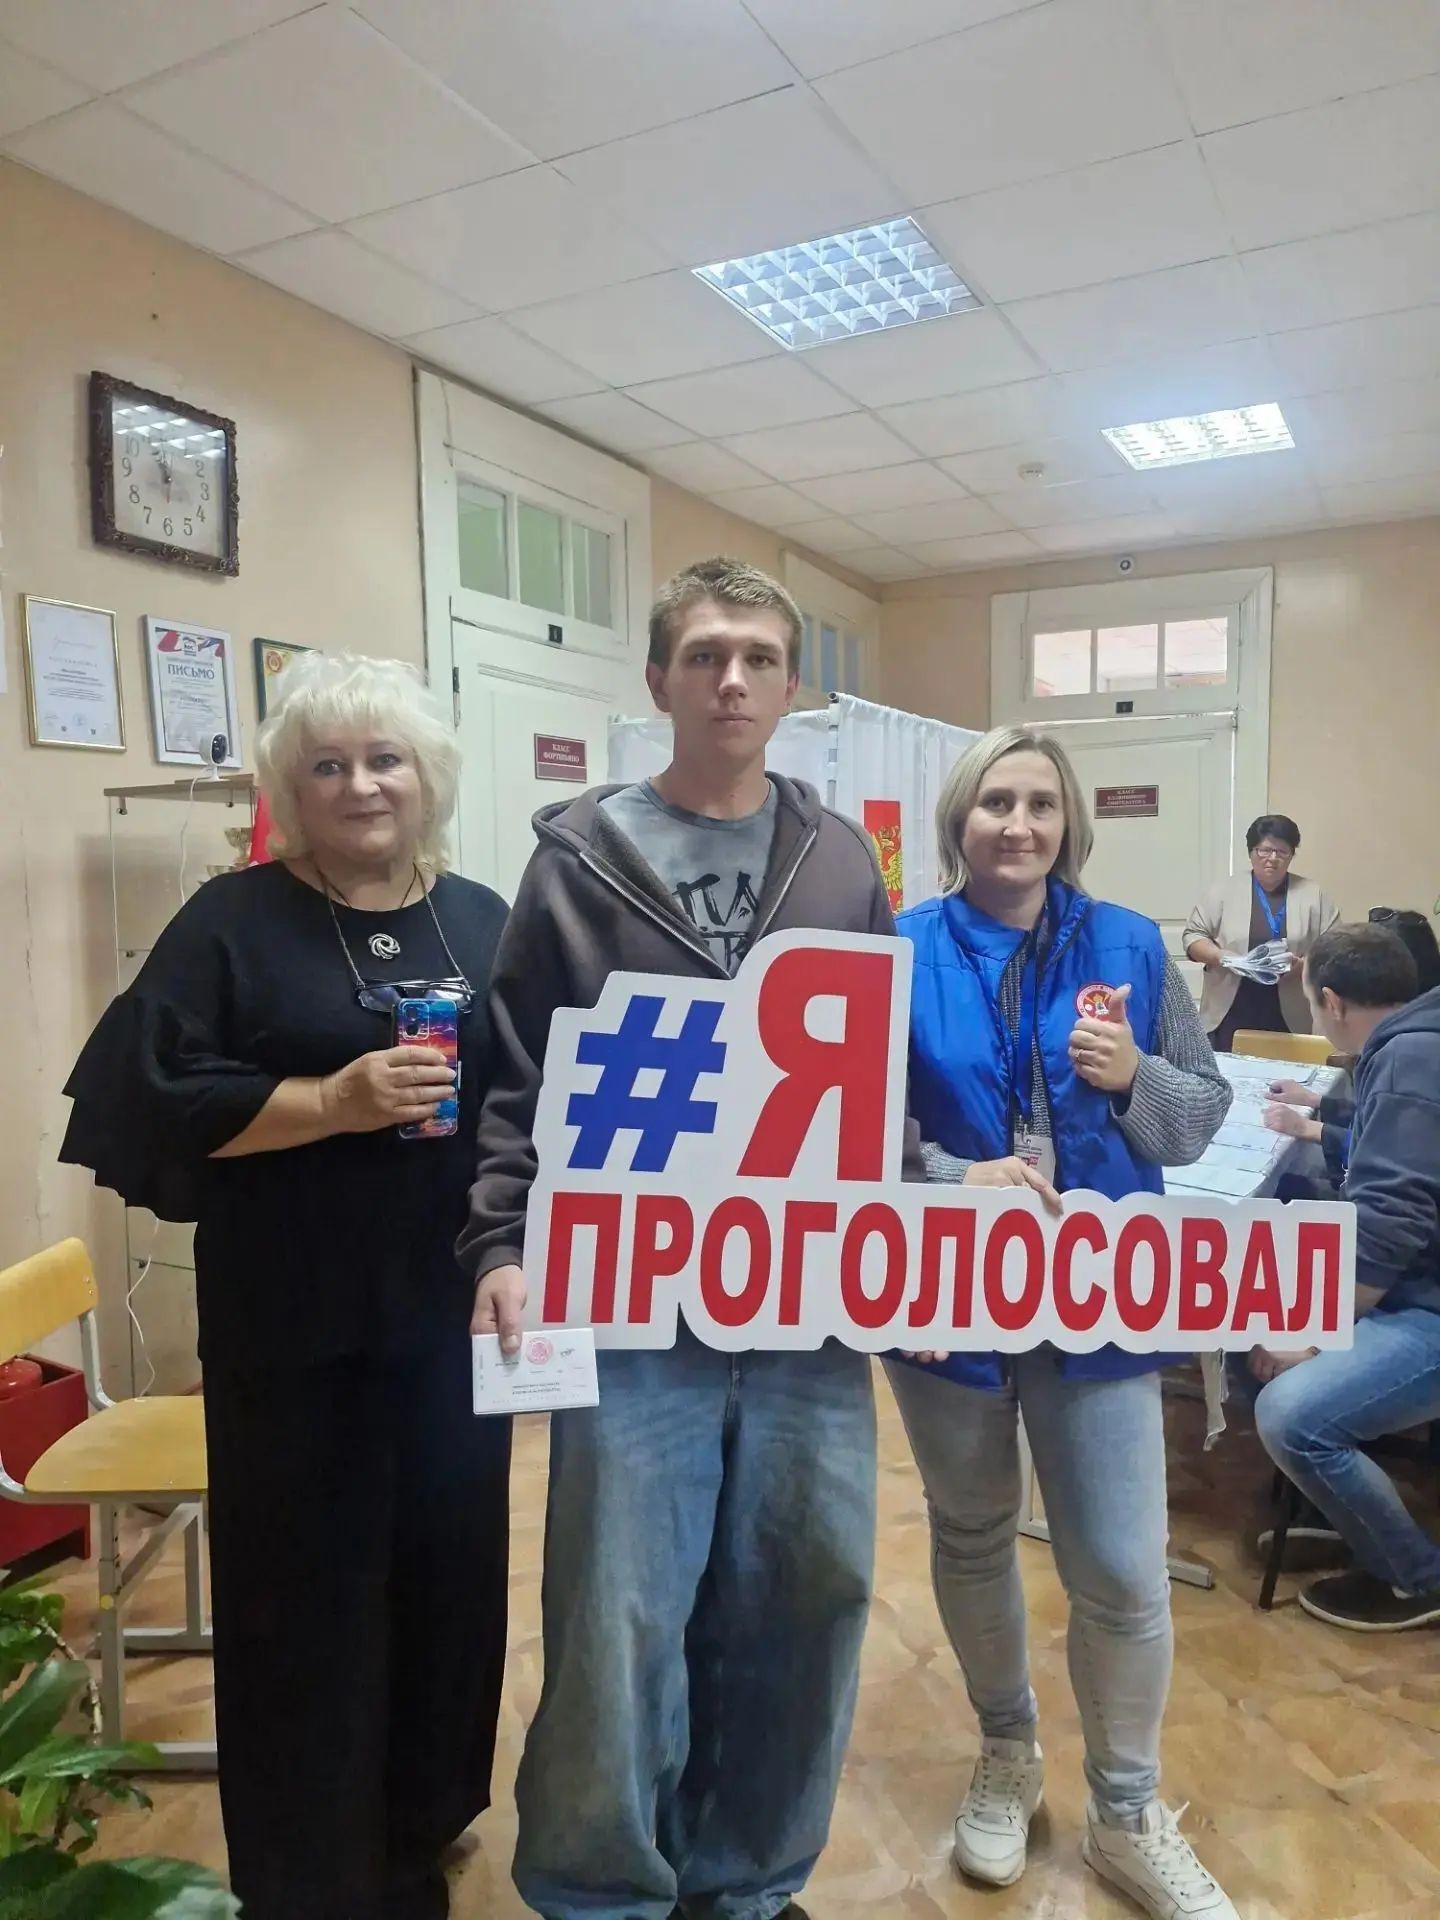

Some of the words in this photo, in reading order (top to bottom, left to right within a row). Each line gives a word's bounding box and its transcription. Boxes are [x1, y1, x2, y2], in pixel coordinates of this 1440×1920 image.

[121, 457, 132, 478] 9
[194, 460, 205, 479] 2
[129, 484, 140, 504] 8
[201, 483, 210, 502] 3
[143, 506, 153, 525] 7
[196, 505, 206, 524] 4
[163, 517, 174, 537] 6
[183, 517, 193, 537] 5
[168, 663, 215, 681] ПИСЬМО
[566, 948, 893, 1182] #Я
[543, 1192, 1341, 1332] ПРОГОЛОСОВАЛ
